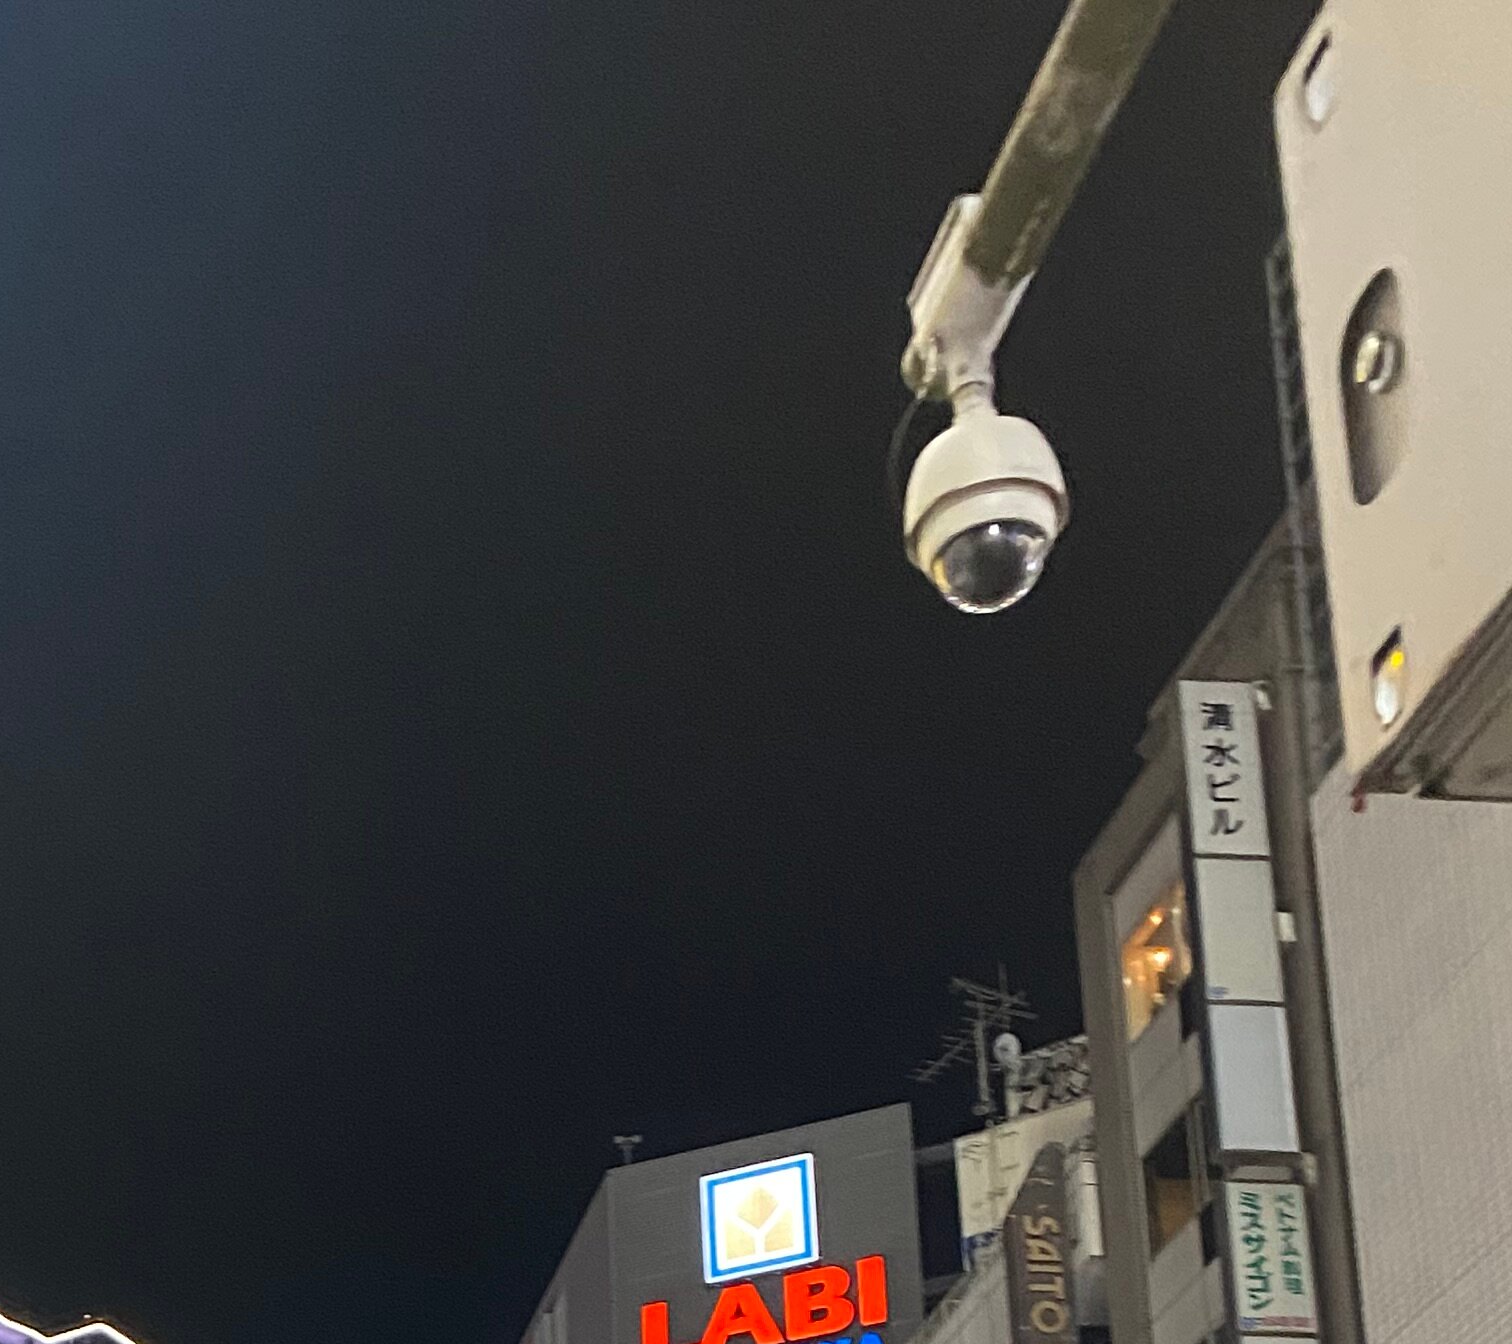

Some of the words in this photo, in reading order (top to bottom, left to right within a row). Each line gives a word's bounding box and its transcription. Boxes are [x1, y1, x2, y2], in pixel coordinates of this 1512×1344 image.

[1199, 702, 1245, 836] 清水ビル
[1022, 1214, 1068, 1334] SAITO
